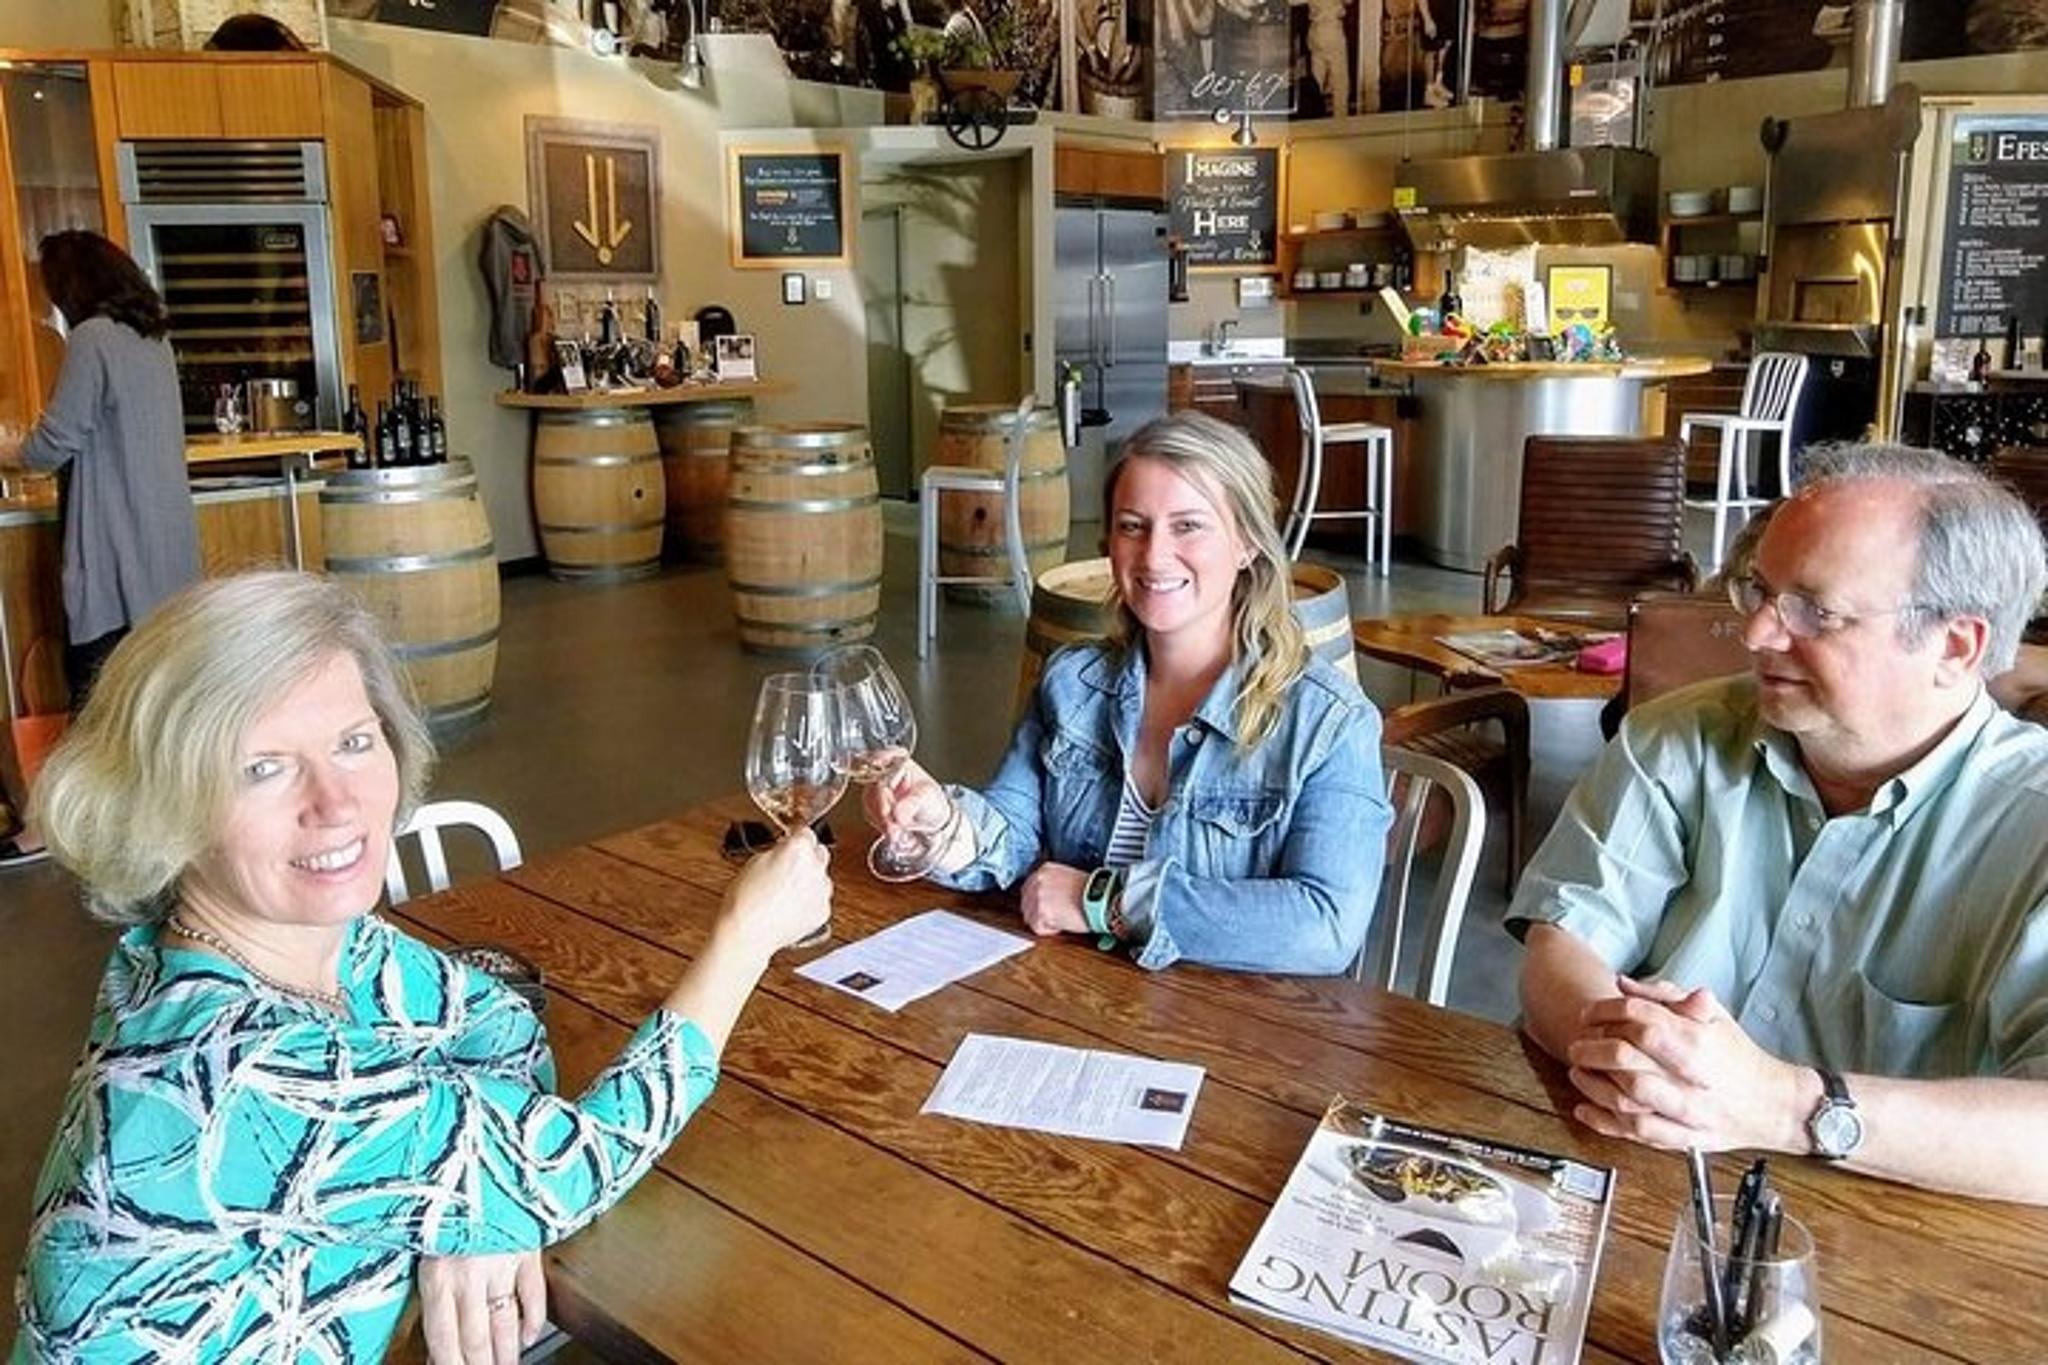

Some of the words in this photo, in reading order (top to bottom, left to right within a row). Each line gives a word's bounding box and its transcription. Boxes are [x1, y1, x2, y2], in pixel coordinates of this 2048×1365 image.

[1192, 208, 1250, 237] HERE
[1256, 1255, 1548, 1365] TASTING
[1344, 1248, 1559, 1335] ROOM
